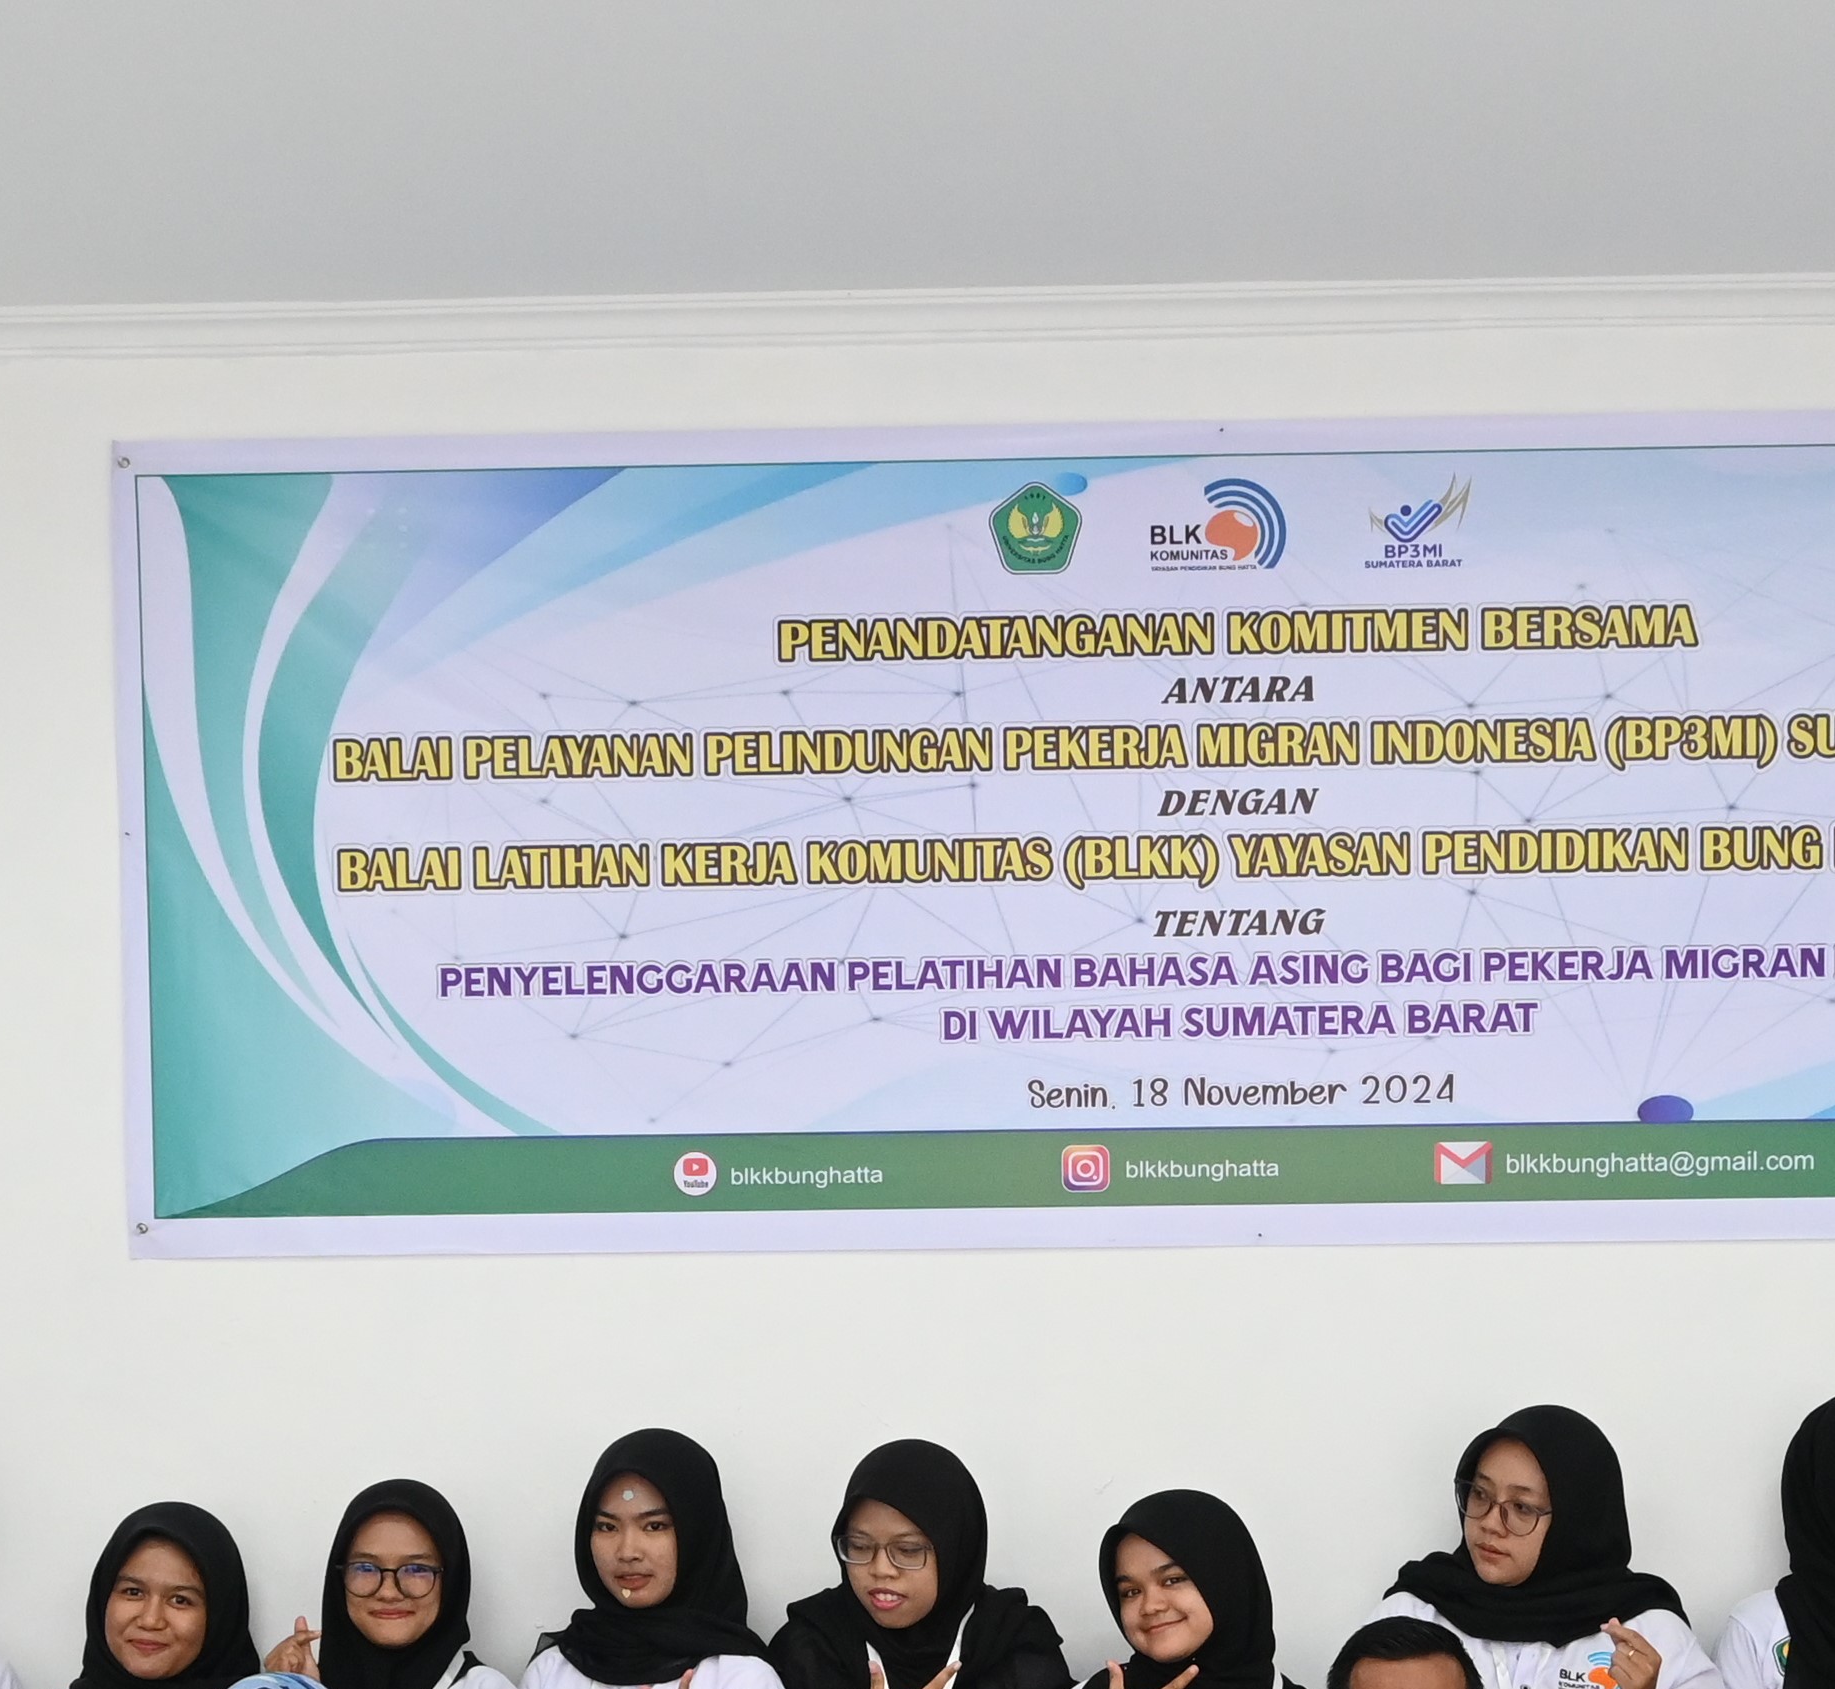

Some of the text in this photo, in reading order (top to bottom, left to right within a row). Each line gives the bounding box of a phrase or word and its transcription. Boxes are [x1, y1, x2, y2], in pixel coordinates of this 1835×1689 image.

[1150, 524, 1202, 545] BLK
[1150, 549, 1228, 561] KOMUNITAS
[1364, 559, 1462, 569] SUMATERA BARAT
[1384, 544, 1443, 558] BP3MI
[778, 605, 1698, 662] PENANDATANGANAN KOMITMEN BERSAMA
[1161, 675, 1314, 704] ANTARA
[333, 737, 453, 782] BALAI
[463, 733, 693, 779] PELAYANAN
[704, 728, 992, 776] PELINDUNGAN
[1004, 724, 1188, 770] PEKERJA
[1197, 722, 1359, 767] MIGRAN
[1371, 718, 1597, 764] INDONESIA
[1605, 714, 1777, 771] (BP3MI)
[1158, 789, 1318, 816] DENGAN
[337, 847, 461, 892] BALAI
[473, 844, 650, 889] LATIHAN
[661, 842, 798, 886] KERJA
[807, 837, 1053, 884] KOMUNITAS
[1064, 834, 1219, 890] (BLKK)
[1227, 832, 1410, 877] YAYASAN
[1423, 828, 1688, 874] PENDIDIKAN
[1701, 825, 1823, 870] BUNG
[1154, 909, 1325, 936] TENTANG
[441, 963, 834, 996] PENYELENGGARAAN
[849, 959, 1061, 990] PELATIHAN
[1075, 957, 1237, 987] BAHASA
[1250, 955, 1368, 984] ASING
[1381, 953, 1470, 982] BAGI
[1485, 951, 1652, 981] PEKERJA
[1666, 948, 1824, 978] MIGRAN
[944, 1003, 1537, 1040] DI WILAYAH SUMATERA BARAT
[1132, 1078, 1168, 1107] 18
[1185, 1078, 1346, 1105] November
[1362, 1074, 1453, 1103] 2024
[731, 1166, 883, 1188] blkkbunghatta
[1126, 1159, 1279, 1182] blkkbunghatta
[1506, 1151, 1814, 1177] blkkbunghatta@gmail.com
[1559, 1668, 1586, 1683] BLK
